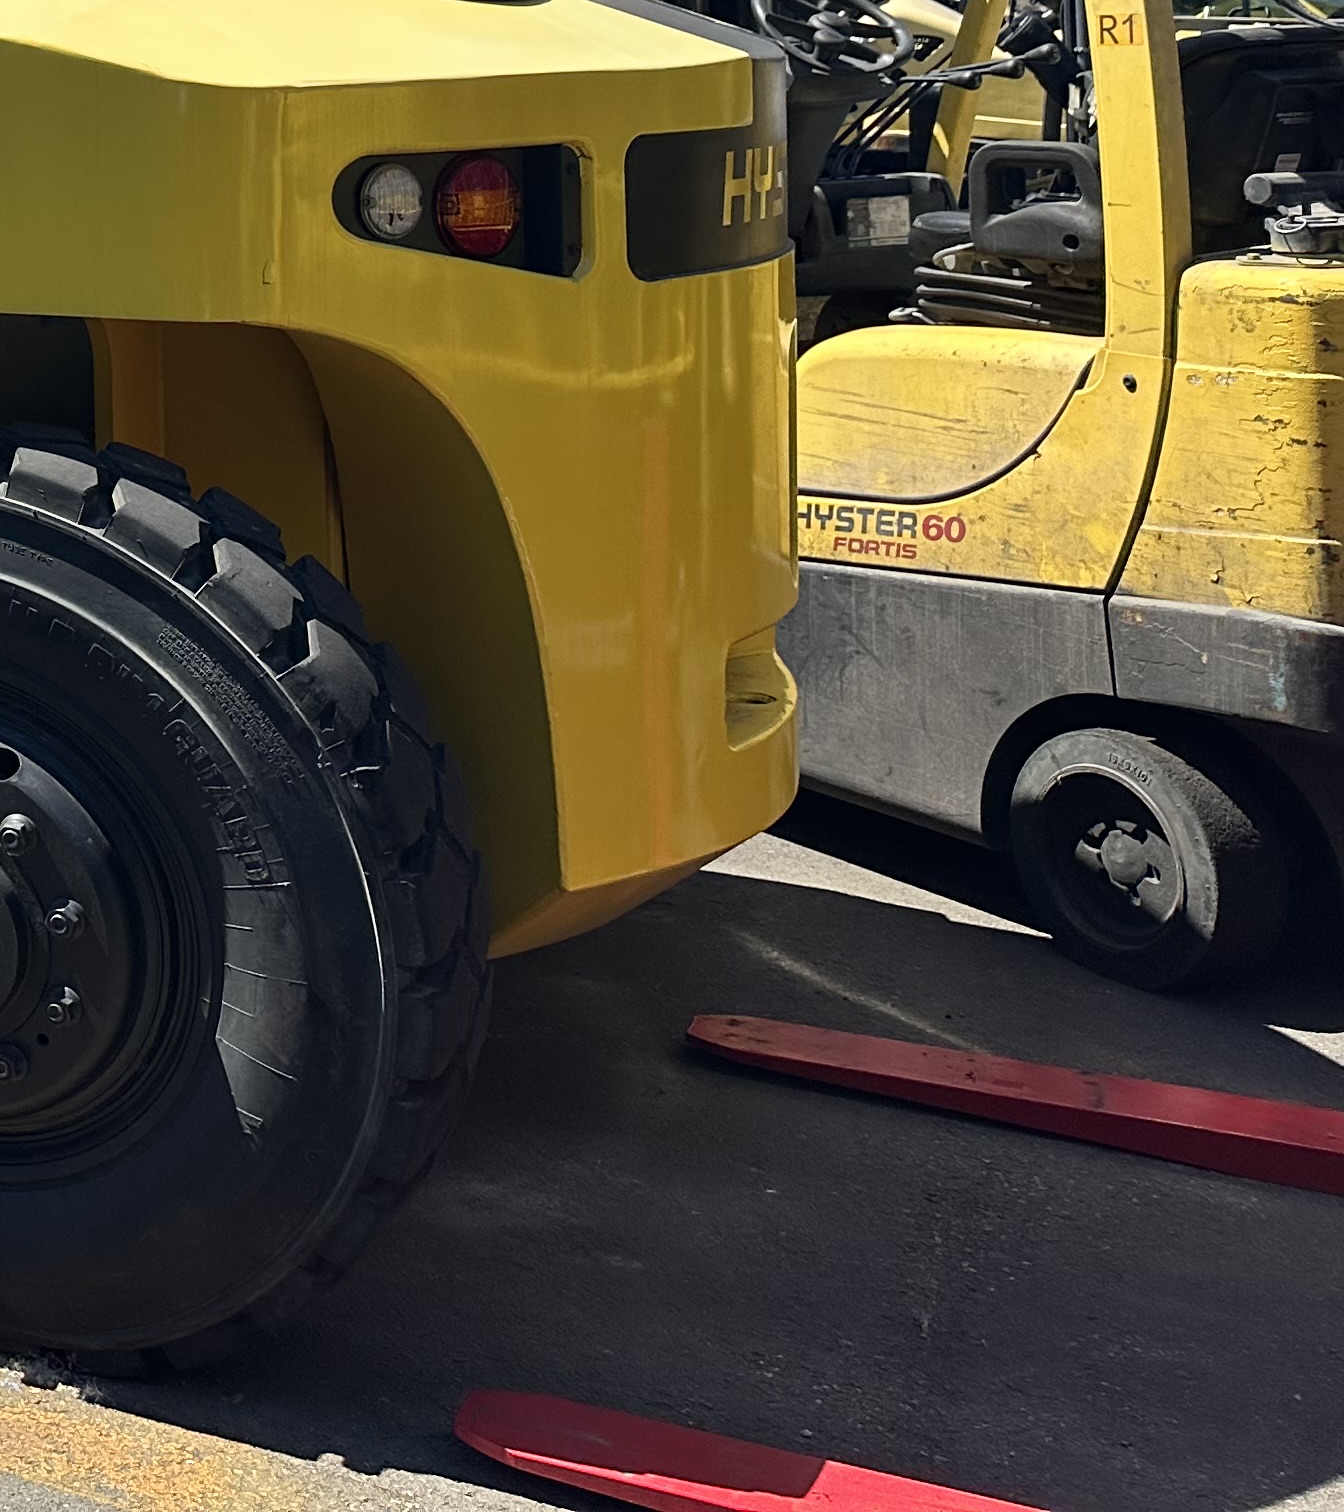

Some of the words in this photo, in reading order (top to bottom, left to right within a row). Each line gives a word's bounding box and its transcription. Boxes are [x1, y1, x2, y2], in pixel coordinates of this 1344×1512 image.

[1099, 13, 1135, 45] R1
[798, 503, 918, 539] HYSTER
[922, 514, 967, 544] 60
[833, 536, 918, 560] FORTIS
